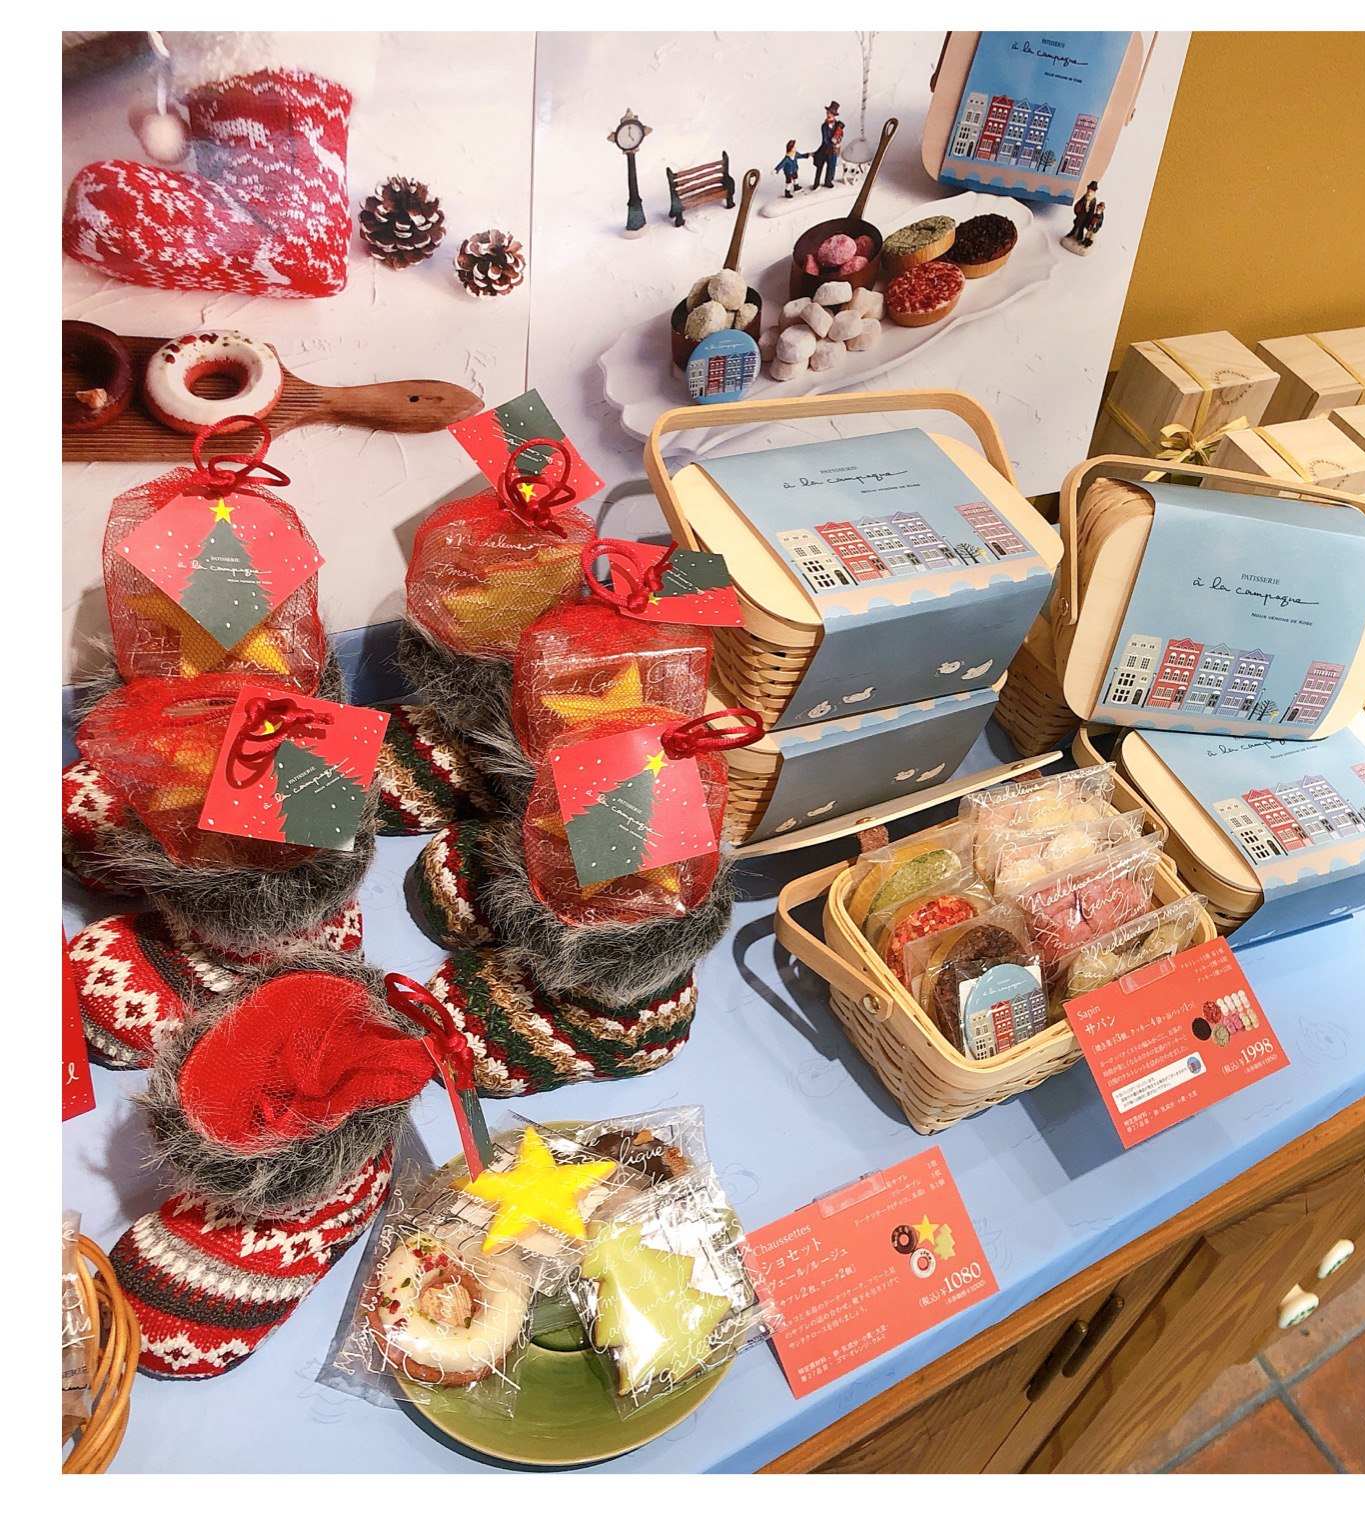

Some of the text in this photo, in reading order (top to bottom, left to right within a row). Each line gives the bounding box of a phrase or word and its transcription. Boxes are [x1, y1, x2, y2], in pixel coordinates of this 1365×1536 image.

[1241, 573, 1280, 585] PATISSERIE
[1236, 587, 1319, 606] campagne
[1076, 1003, 1102, 1022] Sapin
[751, 1222, 813, 1258] Chaussettes
[759, 1235, 825, 1277] ショセット
